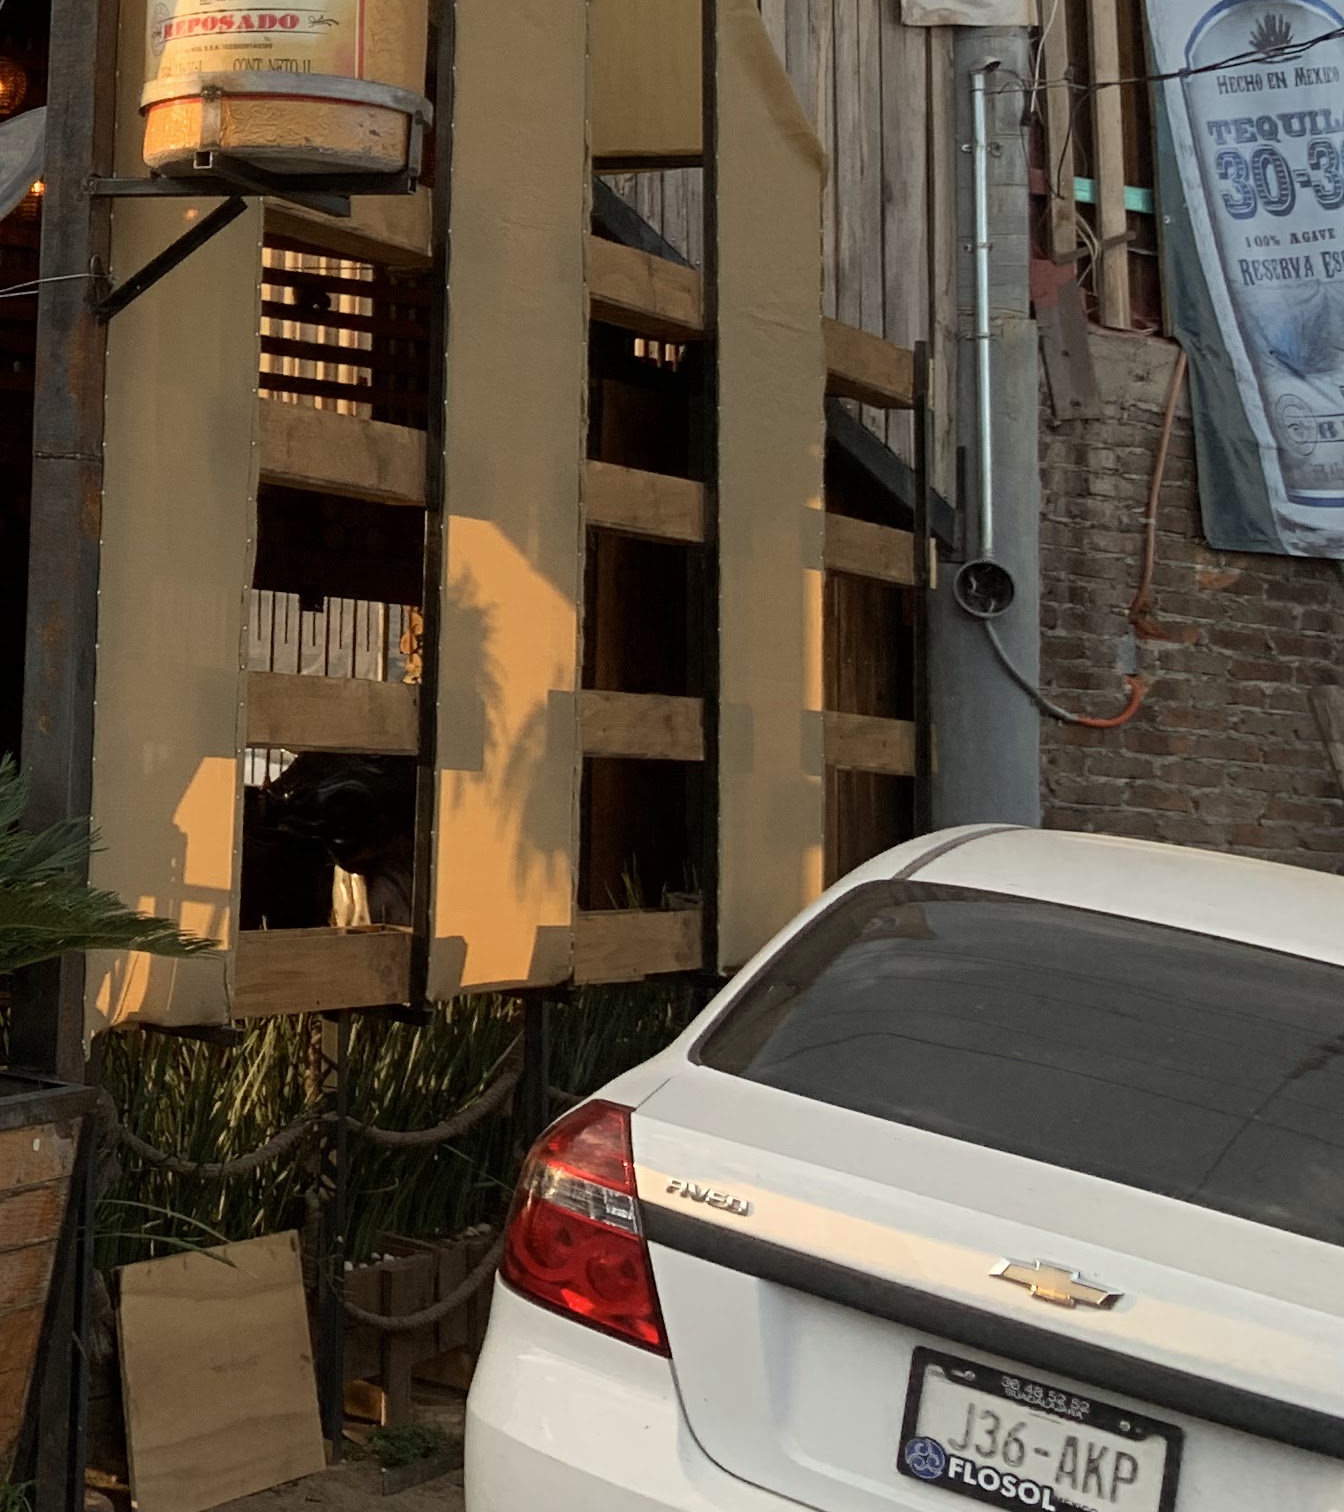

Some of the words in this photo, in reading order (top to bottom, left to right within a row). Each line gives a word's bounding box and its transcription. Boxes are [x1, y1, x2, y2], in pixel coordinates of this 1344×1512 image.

[163, 13, 300, 39] REPOSADO
[1216, 73, 1262, 95] HECHO
[1267, 70, 1288, 90] EN
[1207, 108, 1344, 145] TEQUIL
[1215, 136, 1344, 220] 30-3
[1244, 234, 1280, 249] 100%
[1289, 227, 1336, 245] AGAVE
[1238, 254, 1315, 286] RESERVA
[946, 1401, 1139, 1504] J36-AKP
[947, 1455, 1056, 1512] FLOSOL
